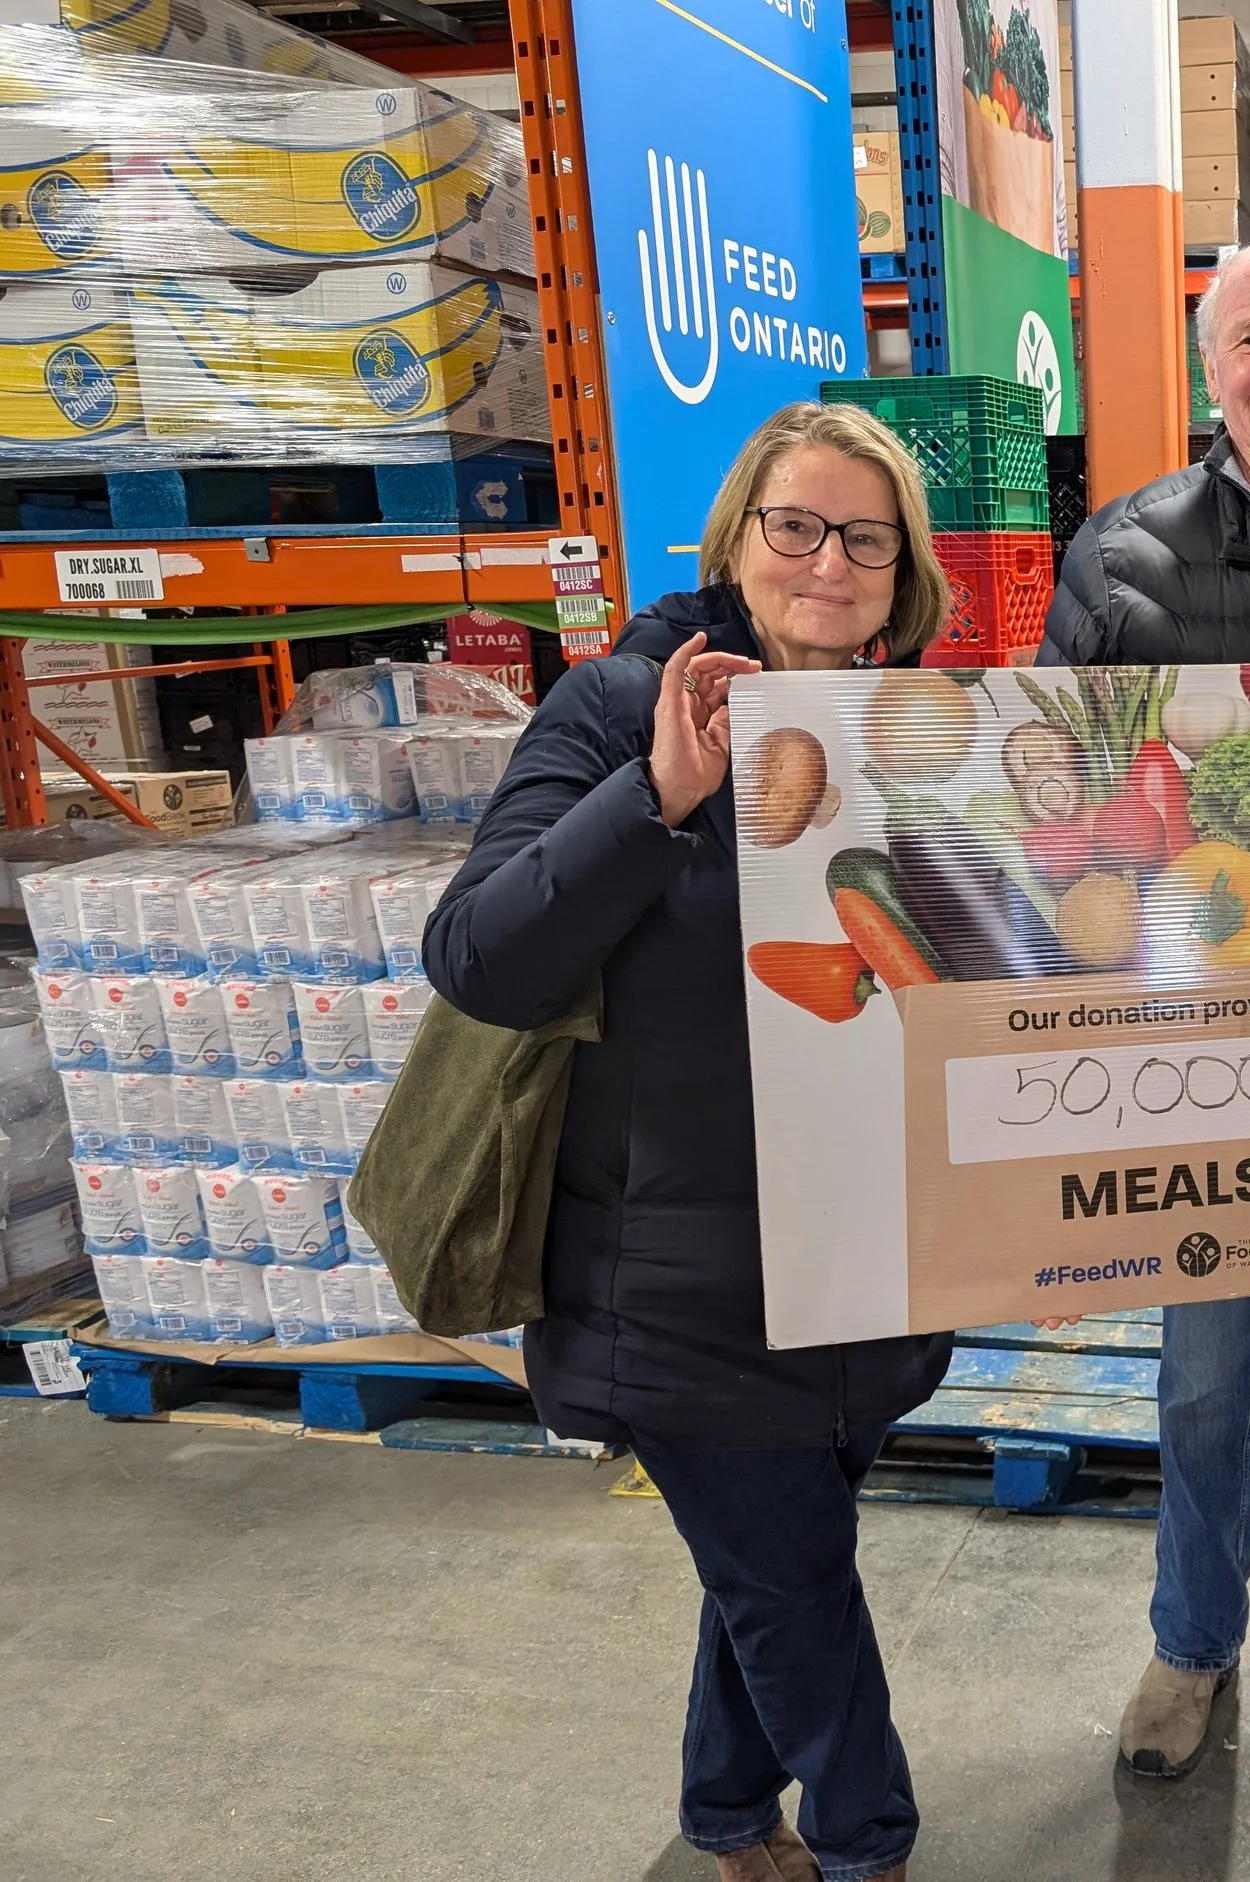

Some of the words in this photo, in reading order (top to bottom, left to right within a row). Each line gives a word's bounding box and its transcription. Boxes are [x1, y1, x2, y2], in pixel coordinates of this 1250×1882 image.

[359, 186, 418, 233] Chiquita
[723, 239, 797, 301] FEED
[729, 306, 847, 375] ONTARIO
[371, 361, 428, 408] Chiquita
[63, 376, 115, 422] Chiquita
[69, 557, 144, 575] DRY.SUGAR.XL
[65, 583, 105, 599] 700068
[560, 579, 594, 592] 0412SC
[564, 612, 598, 624] 0412SB
[456, 634, 521, 647] LETABA
[568, 645, 603, 656] 0412SA
[1008, 1009, 1060, 1031] Our
[1068, 1000, 1195, 1028] donation
[323, 1023, 351, 1034] sugar
[1034, 1256, 1163, 1288] #FeedWR
